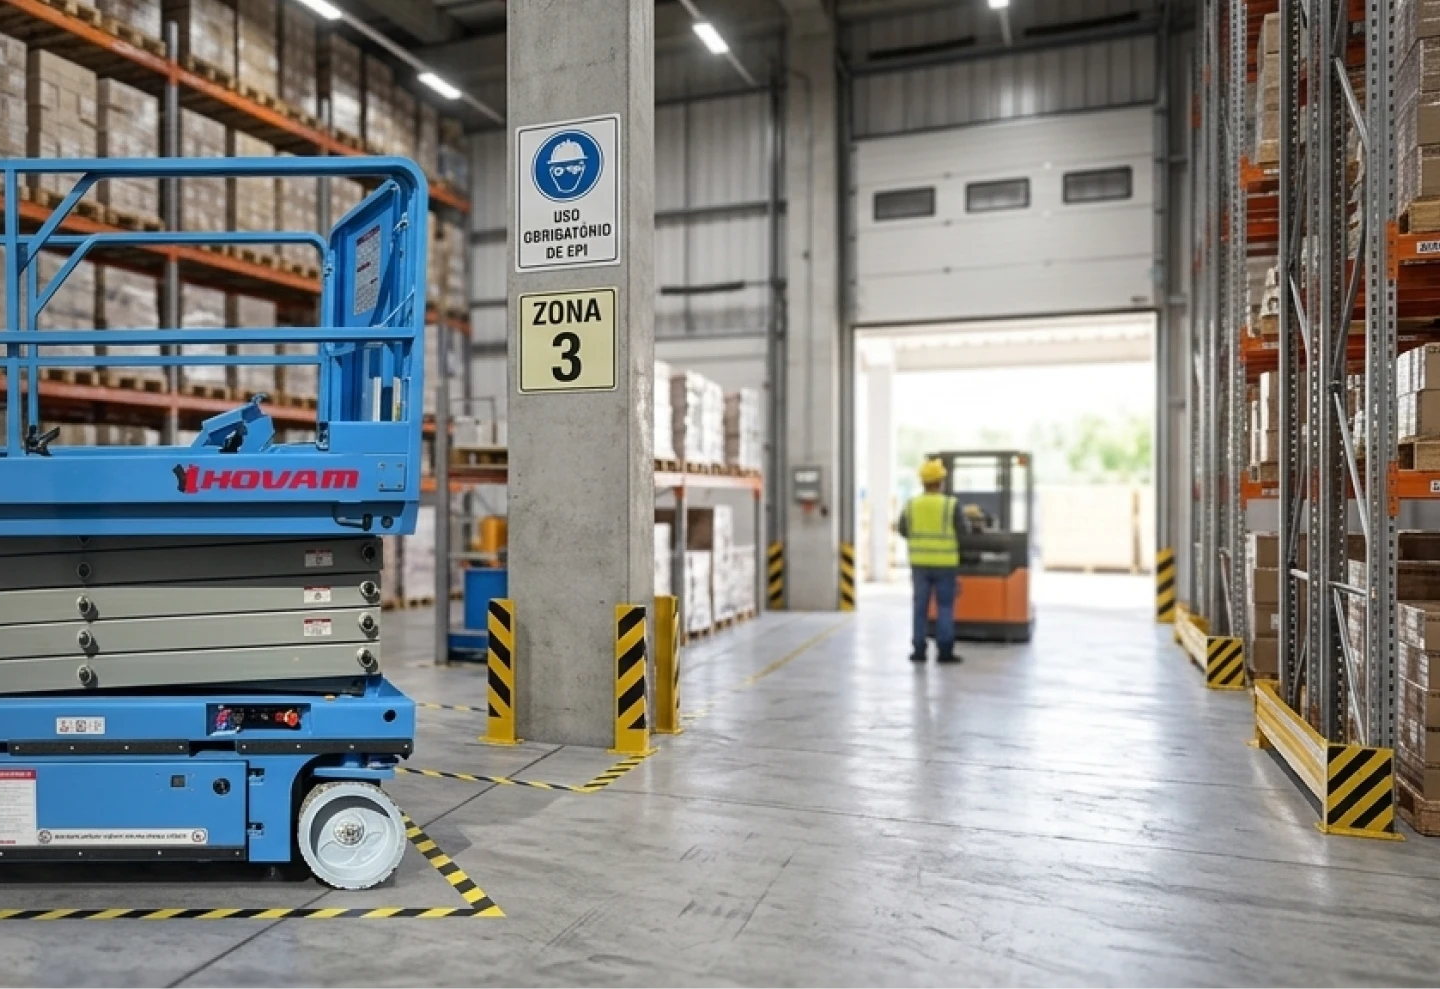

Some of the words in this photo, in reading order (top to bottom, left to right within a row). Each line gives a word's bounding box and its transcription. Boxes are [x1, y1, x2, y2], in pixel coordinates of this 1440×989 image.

[553, 208, 580, 223] USO
[546, 246, 563, 259] DE
[567, 244, 588, 257] EPI
[532, 298, 602, 325] ZONA
[552, 331, 582, 382] 3
[200, 470, 360, 489] HOVAM
